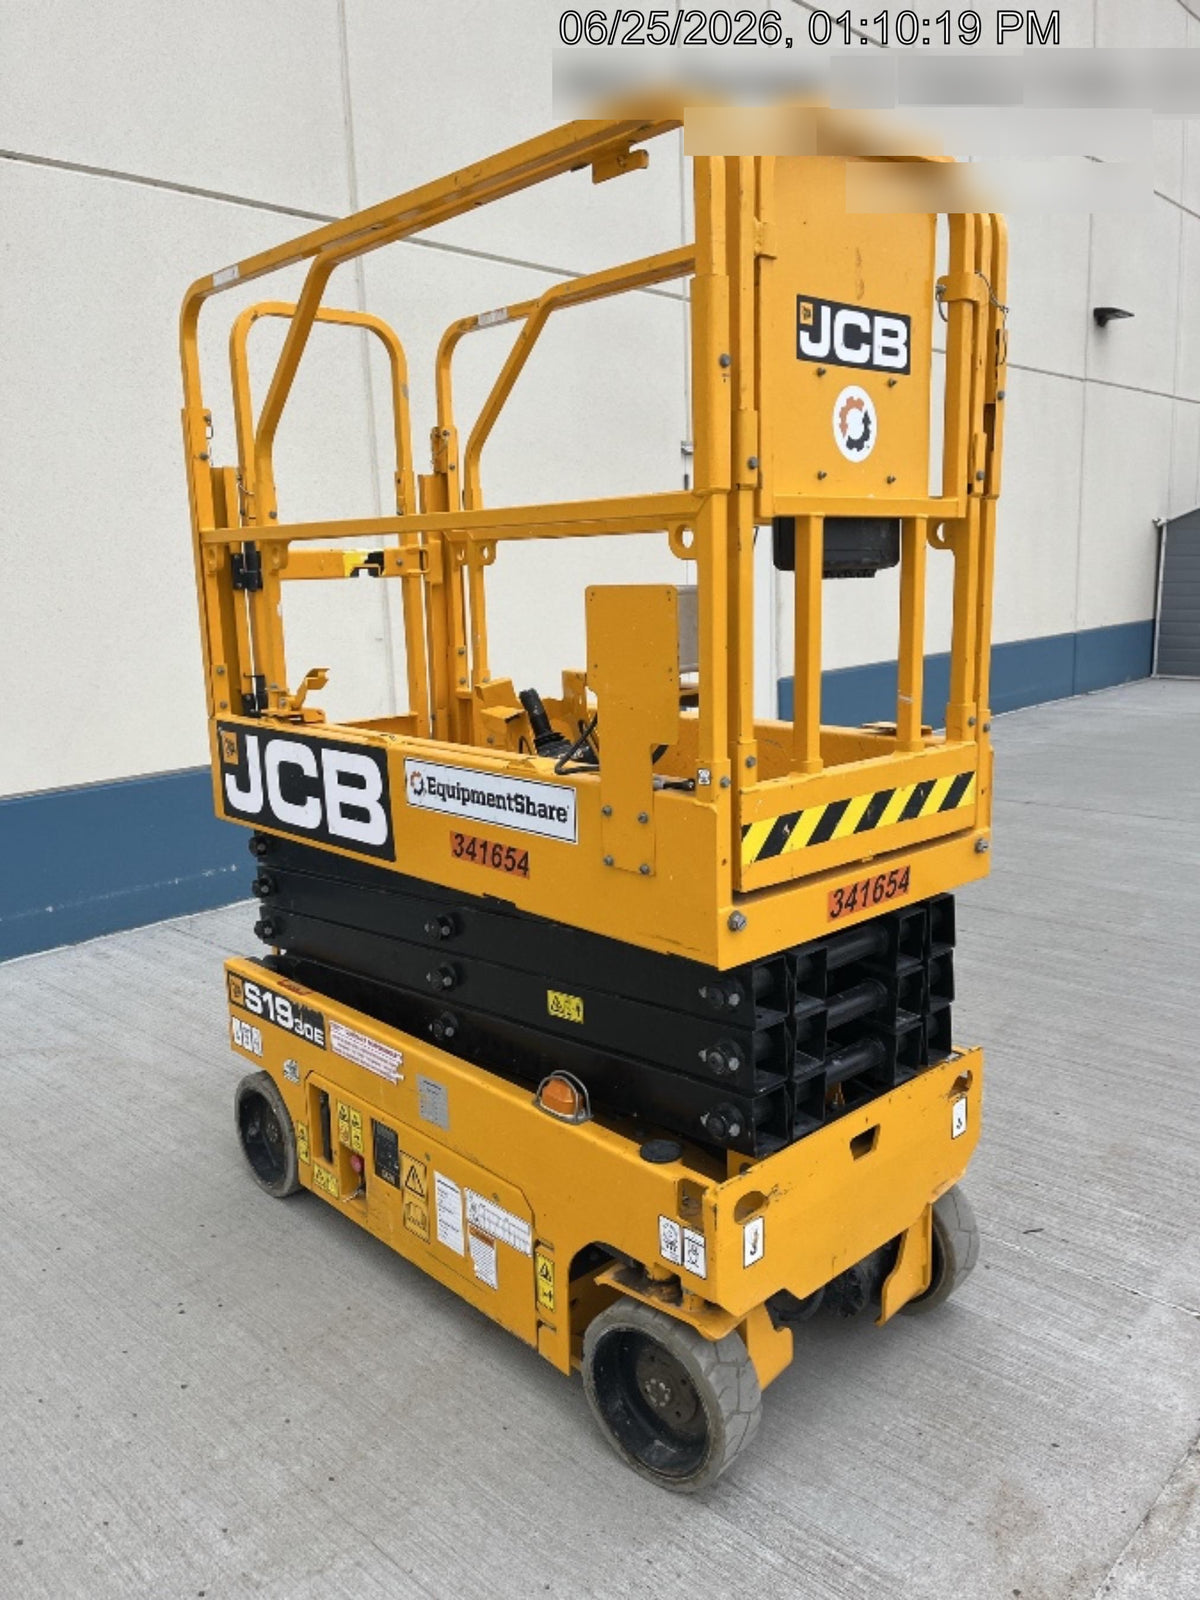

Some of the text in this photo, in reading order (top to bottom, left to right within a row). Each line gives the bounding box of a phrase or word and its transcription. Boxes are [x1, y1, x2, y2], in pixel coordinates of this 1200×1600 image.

[800, 305, 907, 369] JCB
[225, 734, 388, 846] JCB
[426, 776, 568, 823] EquipmentShare
[453, 833, 529, 876] 341654
[830, 865, 910, 918] 341654
